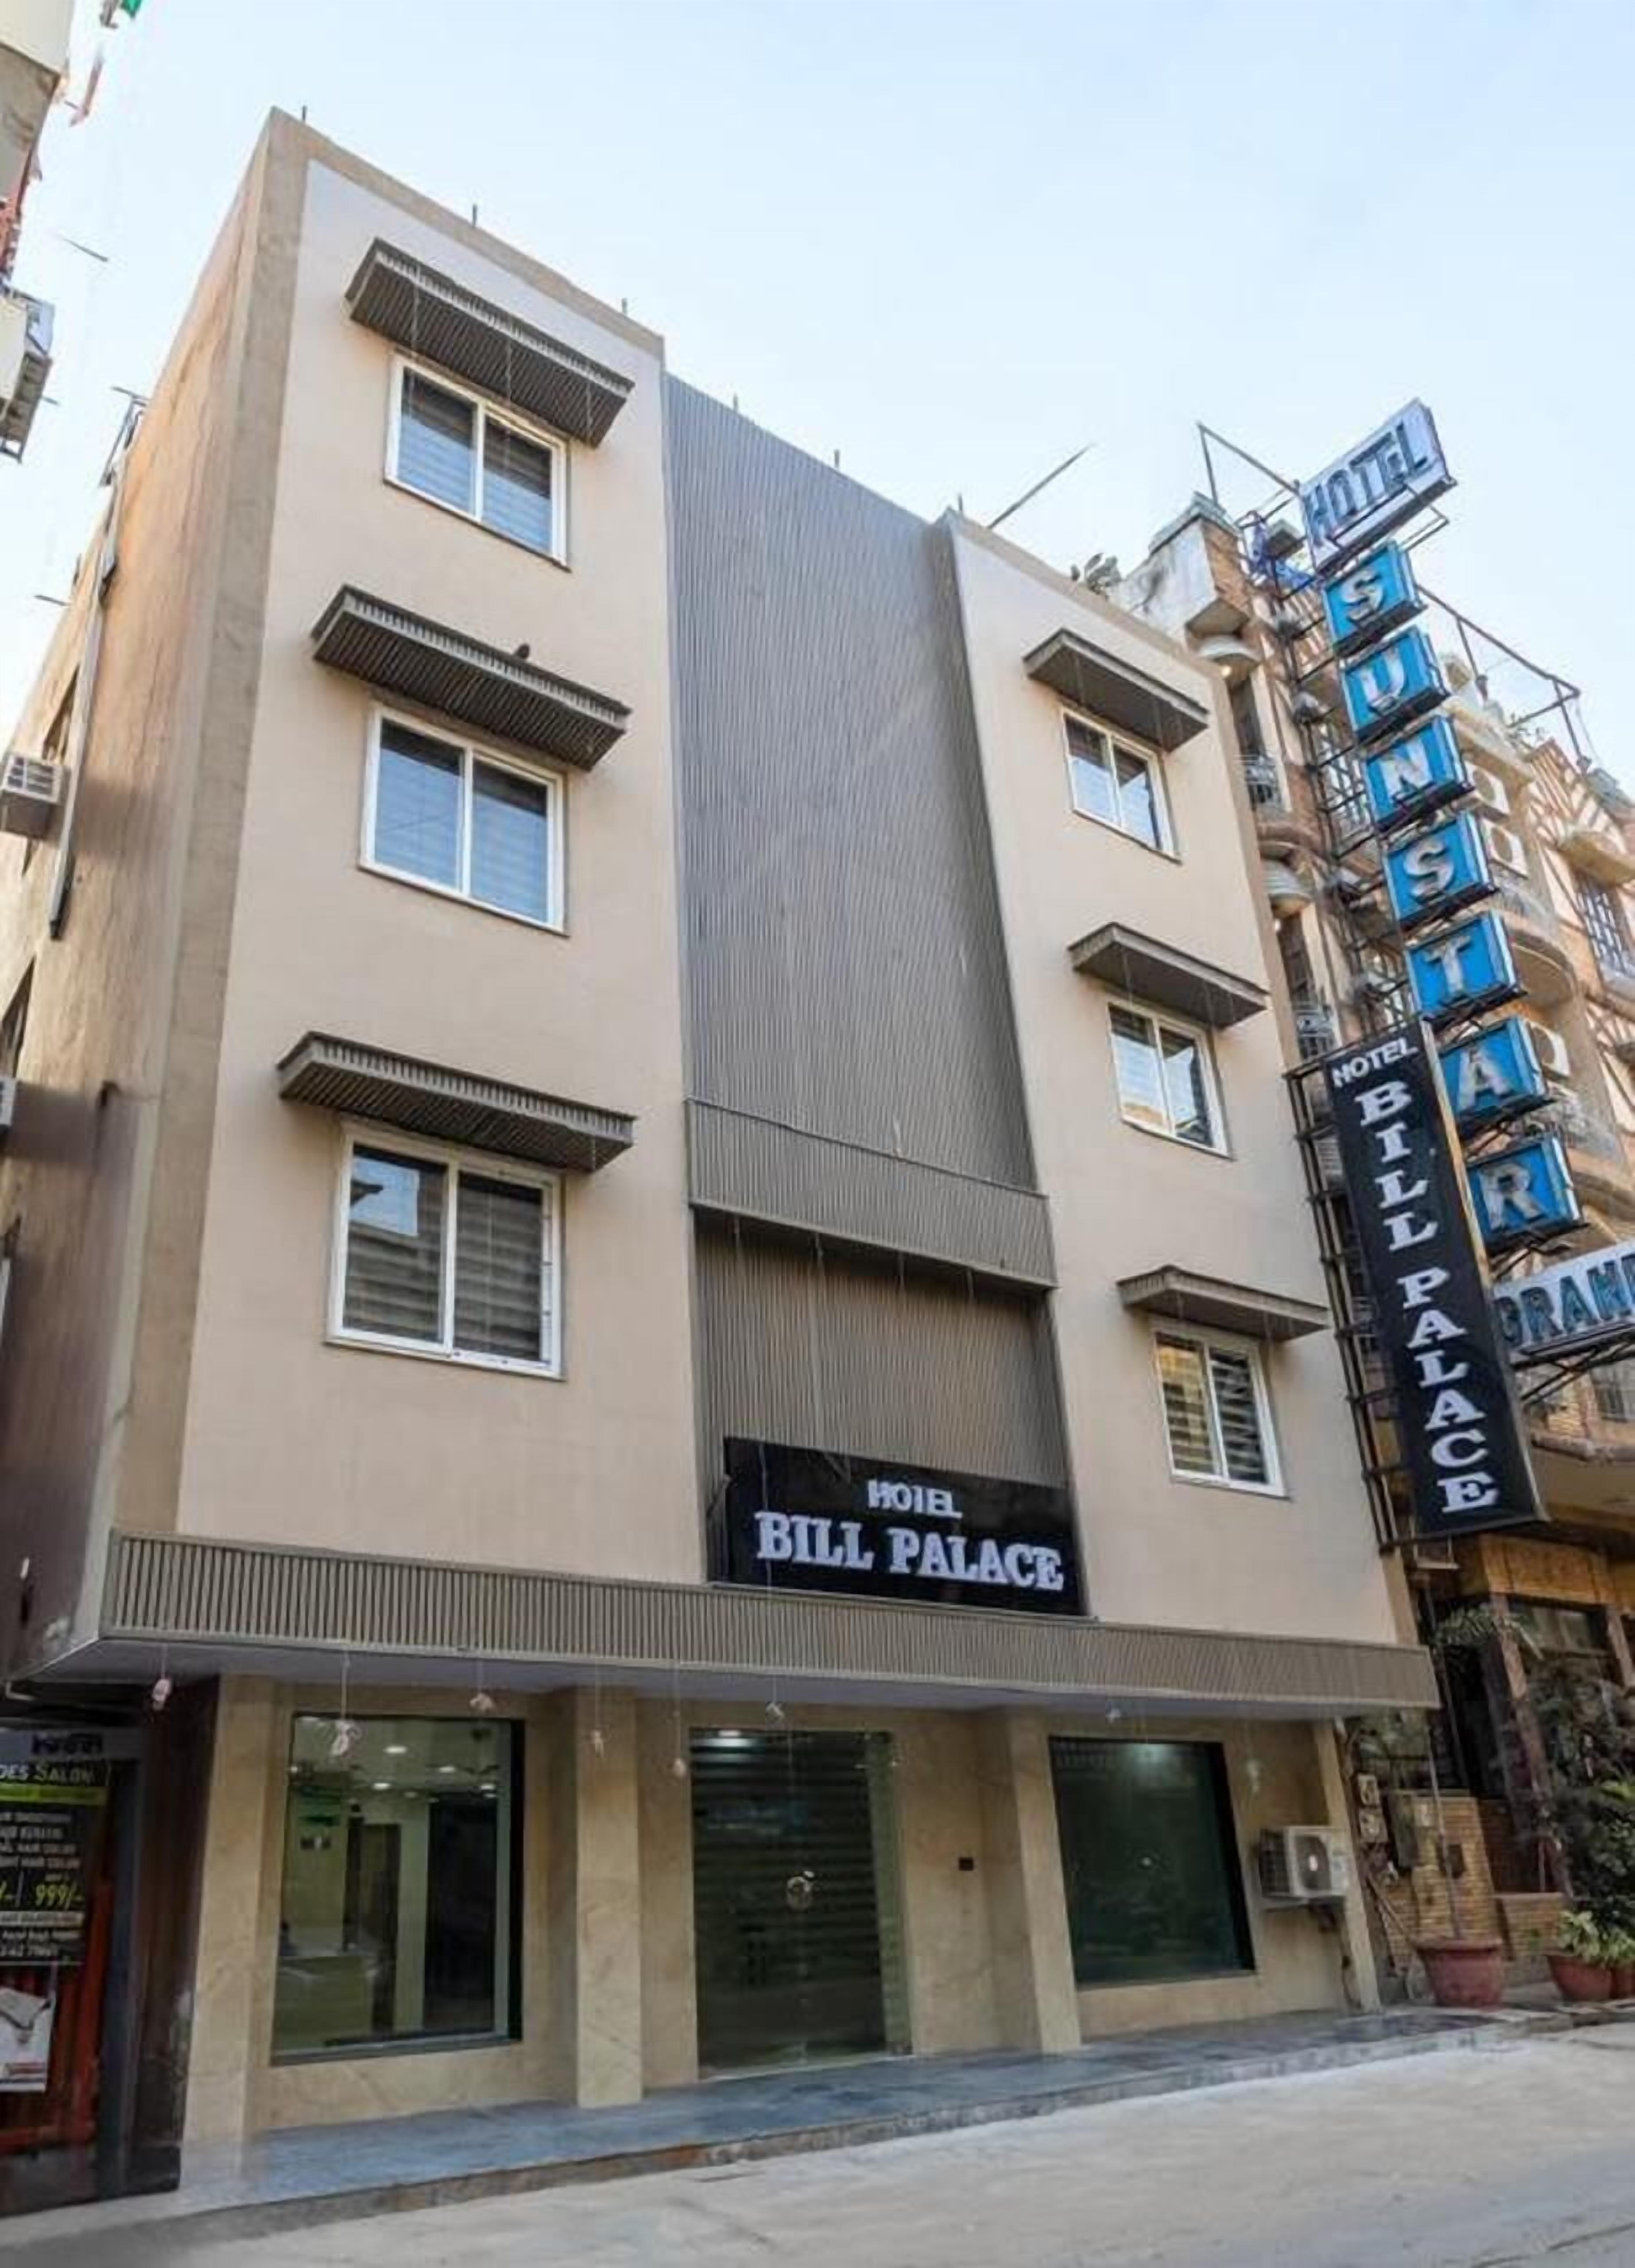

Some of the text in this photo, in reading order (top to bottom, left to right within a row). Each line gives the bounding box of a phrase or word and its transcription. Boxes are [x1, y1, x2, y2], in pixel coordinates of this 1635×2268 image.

[1304, 419, 1428, 548] HOTEL
[1332, 1037, 1418, 1088] HOTEL
[1355, 1080, 1499, 1513] BILL PALACE
[868, 1479, 962, 1519] HOTEL
[754, 1511, 1064, 1591] BILL PALACE
